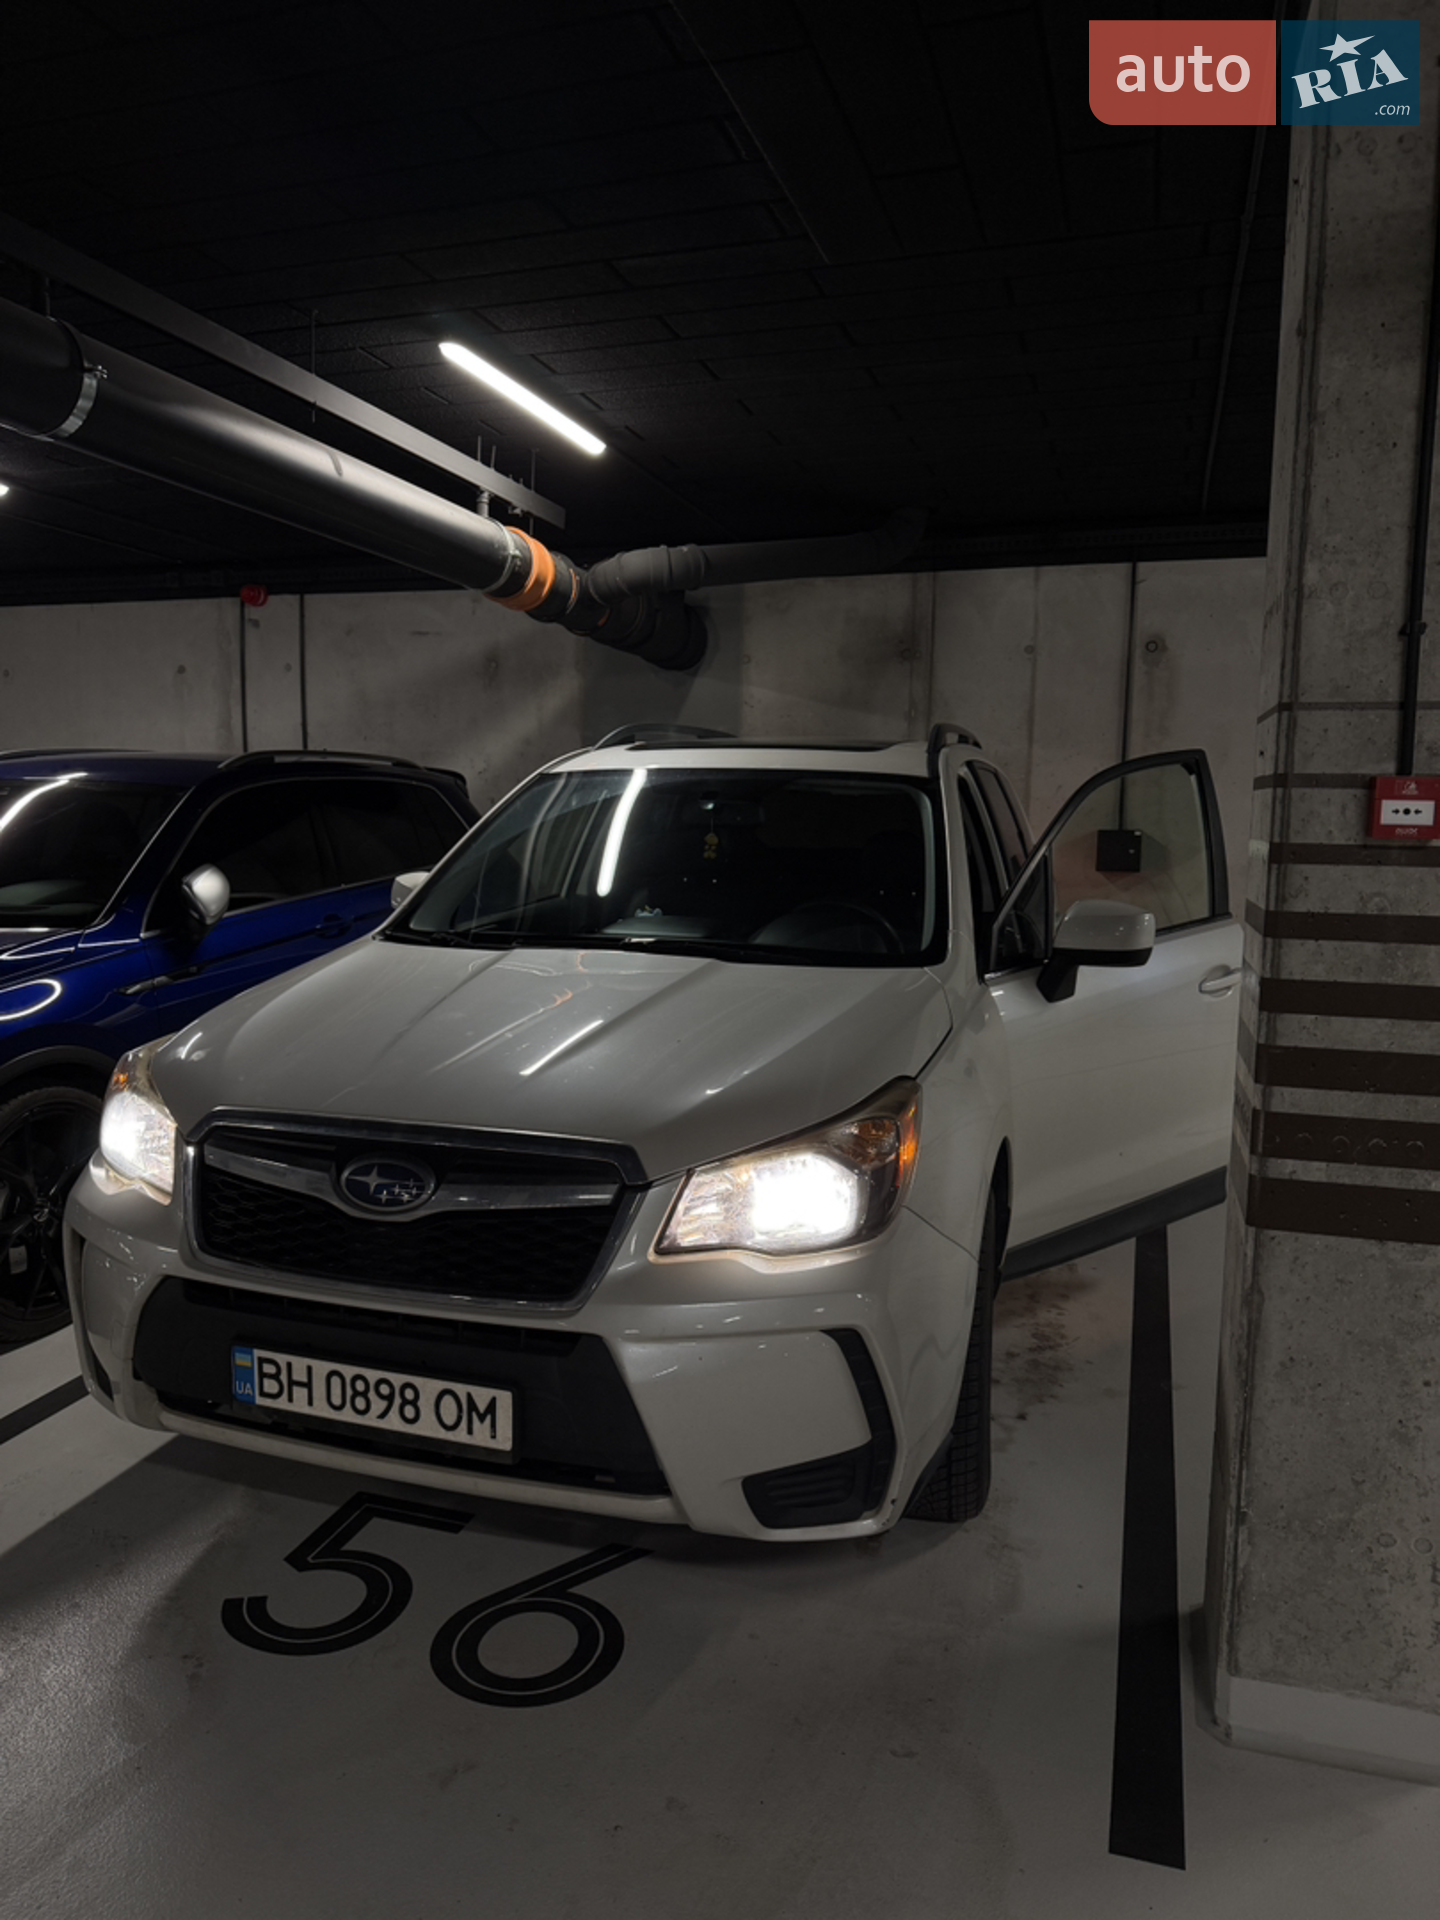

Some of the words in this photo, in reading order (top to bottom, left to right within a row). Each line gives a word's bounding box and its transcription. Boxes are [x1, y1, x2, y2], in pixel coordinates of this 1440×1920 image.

[235, 1380, 254, 1397] UA
[257, 1356, 313, 1406] BH
[326, 1370, 421, 1424] 0898
[435, 1388, 497, 1439] OM
